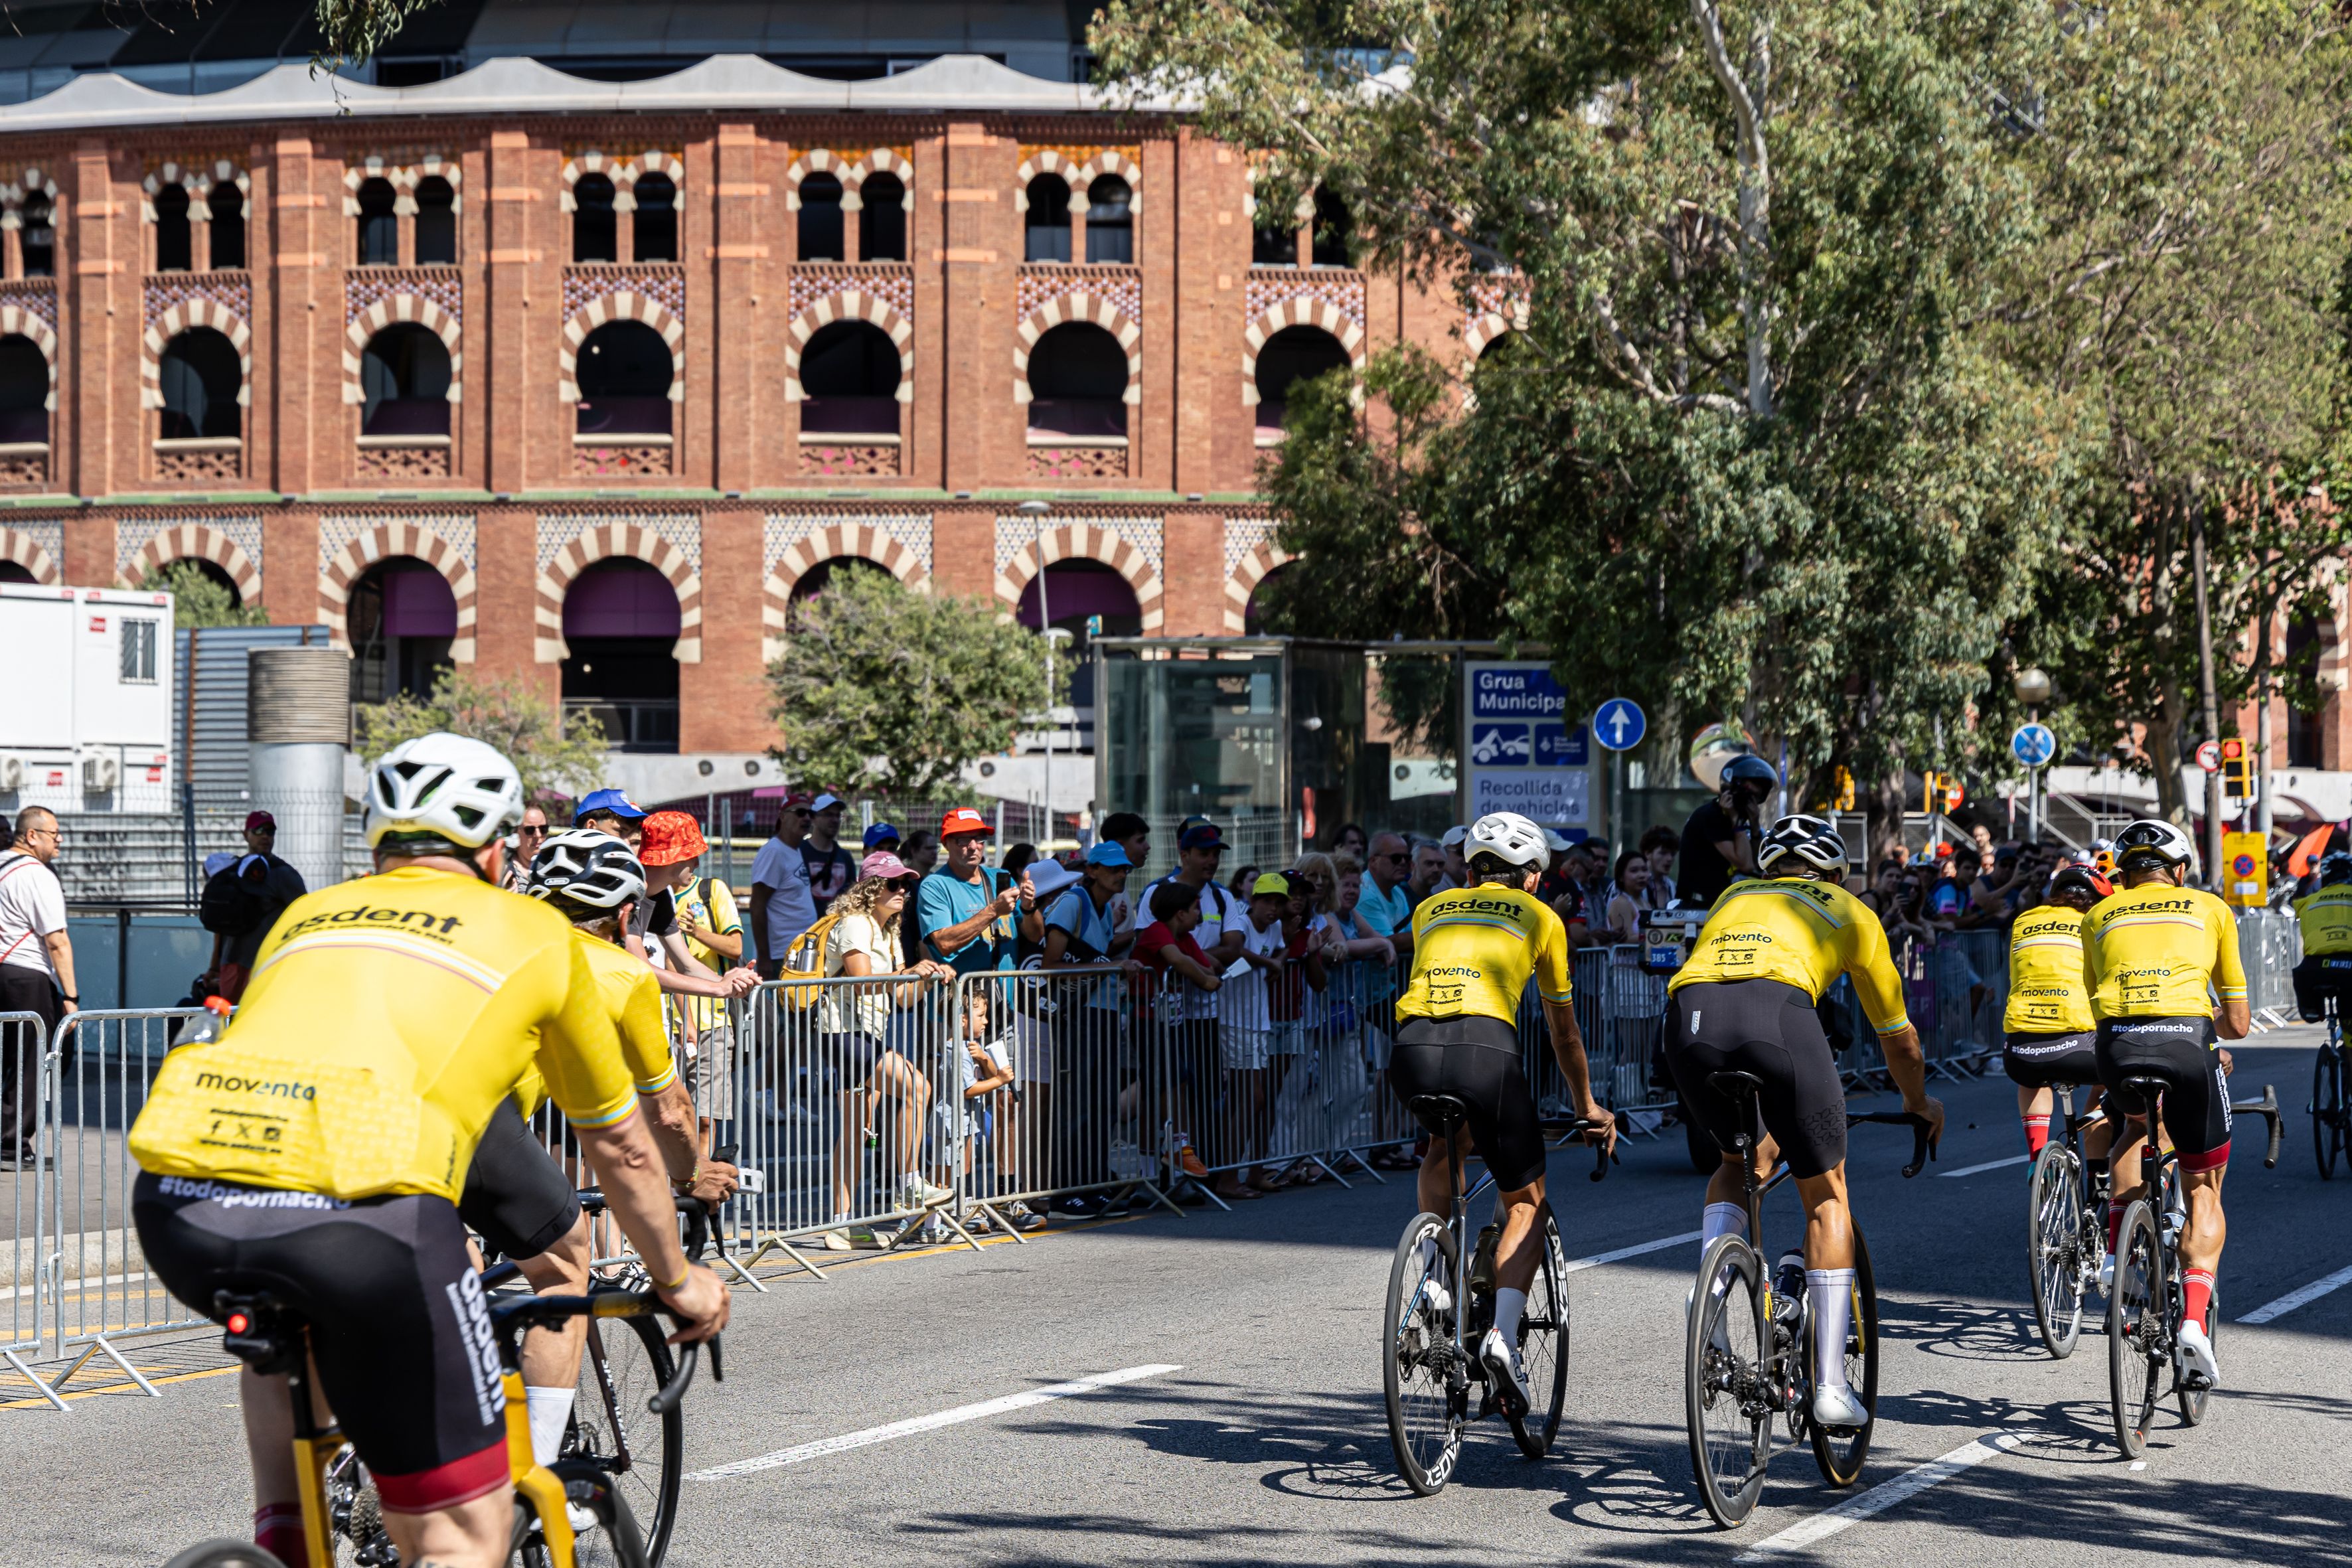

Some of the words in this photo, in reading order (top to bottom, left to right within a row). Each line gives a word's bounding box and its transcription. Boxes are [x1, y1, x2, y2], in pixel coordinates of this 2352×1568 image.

[1480, 672, 1525, 689] Grua
[1480, 779, 1562, 796] Recollida
[1480, 799, 1502, 814] de
[1508, 799, 1580, 815] vehicles
[1431, 898, 1524, 916] asdent
[2102, 900, 2194, 921] asdent
[281, 905, 463, 941] asdent
[1711, 933, 1772, 945] movento
[2021, 988, 2069, 996] movento
[2112, 1024, 2193, 1034] #todopornacho
[2012, 1040, 2078, 1056] #todopornacho
[196, 1073, 316, 1101] movento
[1546, 1215, 1569, 1330] CADEX
